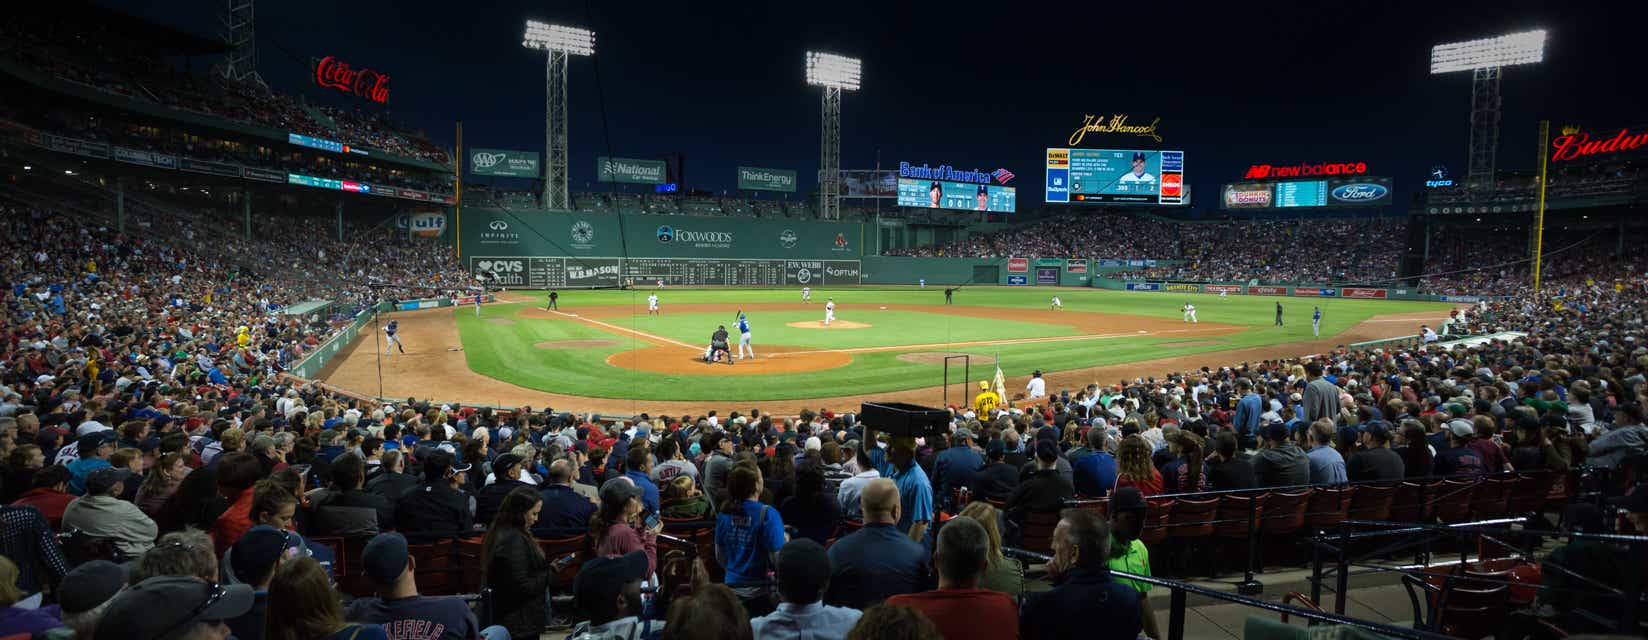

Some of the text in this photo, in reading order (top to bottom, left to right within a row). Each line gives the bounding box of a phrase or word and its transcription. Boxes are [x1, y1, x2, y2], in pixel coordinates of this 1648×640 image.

[1069, 114, 1163, 146] John Hancock
[617, 163, 661, 177] National
[900, 161, 991, 184] Bank of America
[742, 170, 791, 185] ThinkEnergy
[1425, 180, 1454, 188] tyco
[1342, 188, 1377, 201] Ford
[399, 215, 444, 229] Gulf
[675, 229, 732, 243] FOXWOODS
[493, 260, 524, 272] CVS
[834, 269, 859, 277] OPTUM
[384, 619, 446, 640] EFIELD
